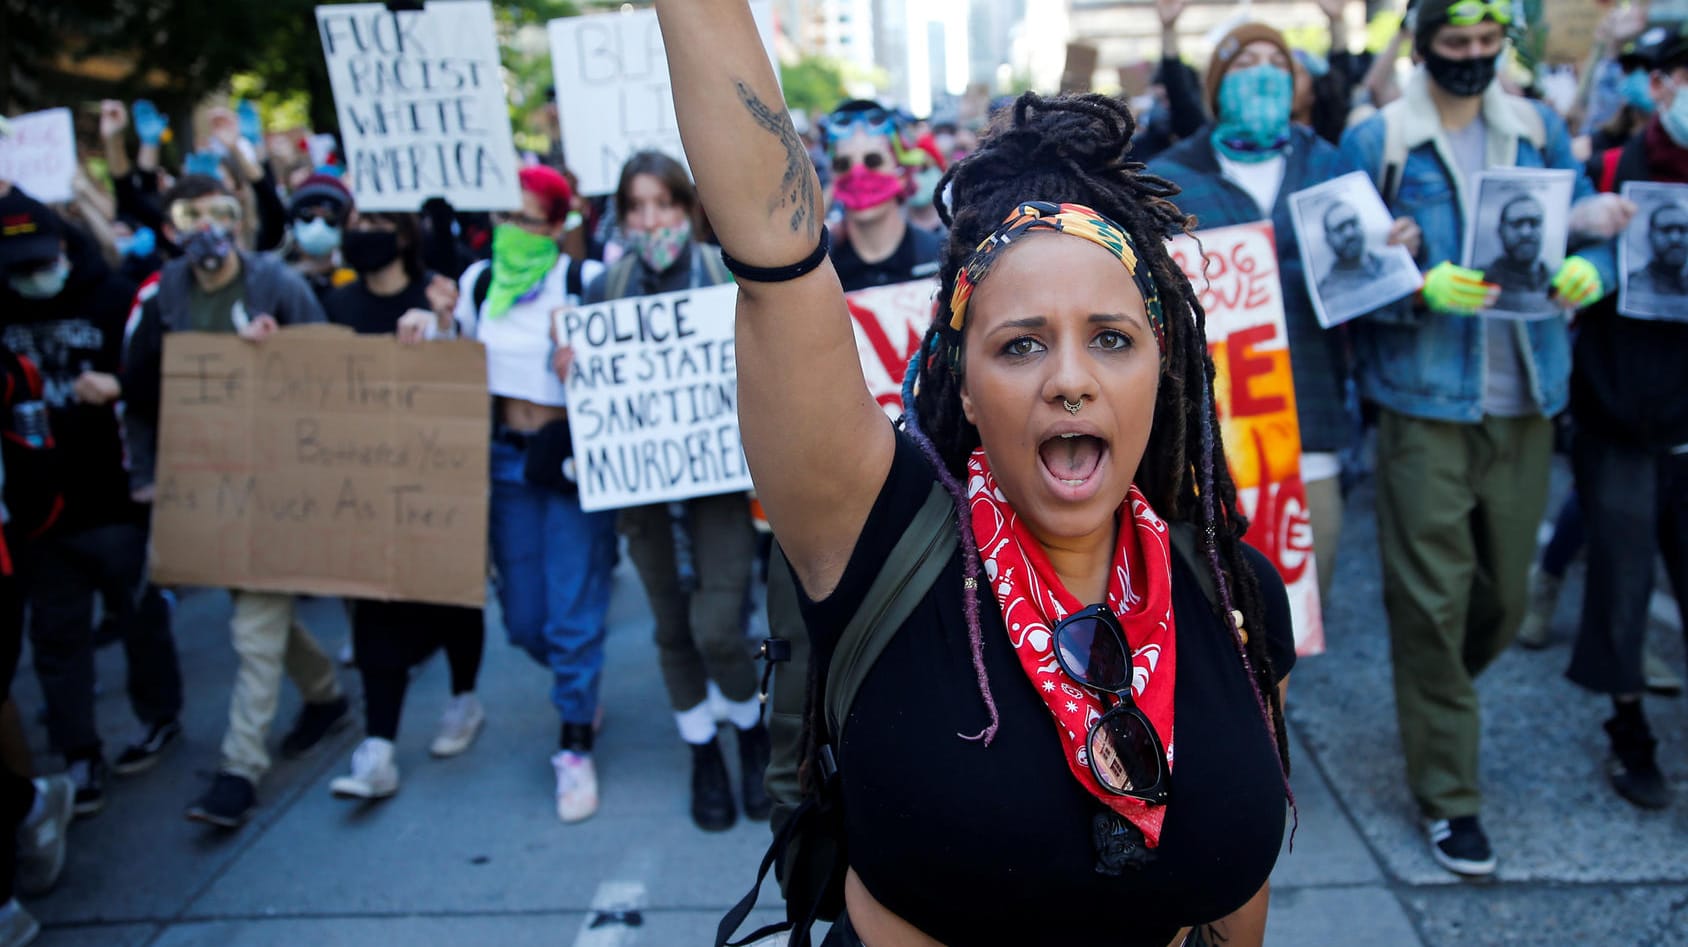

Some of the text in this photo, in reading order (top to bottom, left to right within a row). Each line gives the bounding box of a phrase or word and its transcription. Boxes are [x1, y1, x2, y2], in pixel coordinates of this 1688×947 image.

[324, 10, 426, 54] FUCK
[347, 57, 486, 95] RACIST
[347, 97, 490, 136] WHITE
[354, 140, 505, 193] AMERICA
[1199, 270, 1274, 315] OVE
[564, 299, 696, 348] POLICE
[572, 340, 735, 388] ARE STATE
[332, 476, 376, 522] As
